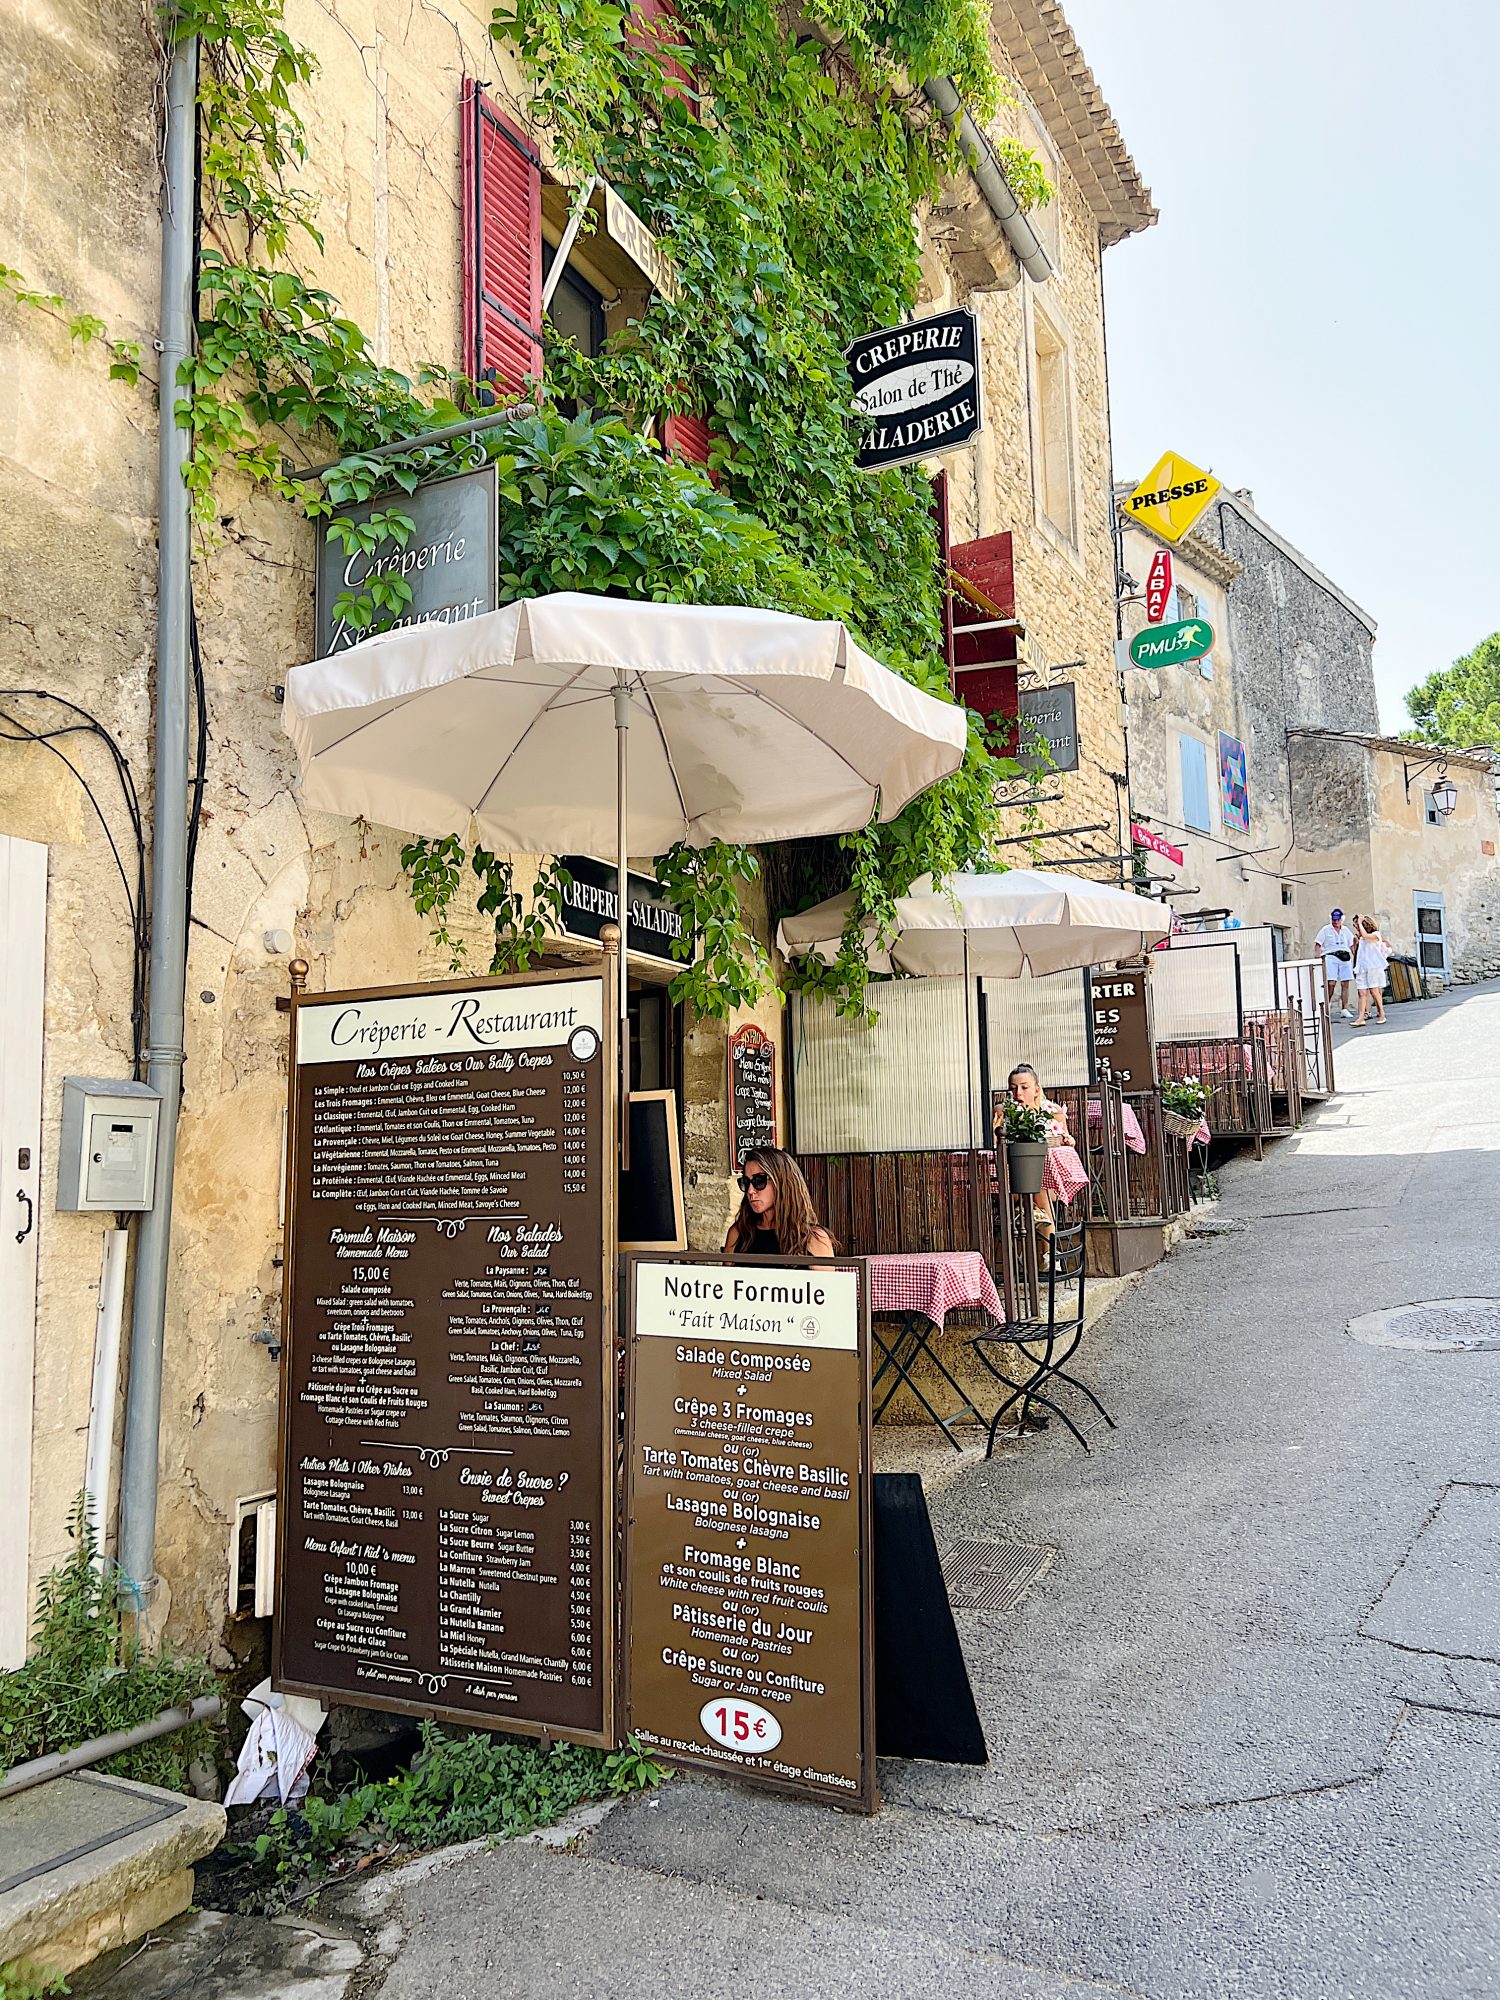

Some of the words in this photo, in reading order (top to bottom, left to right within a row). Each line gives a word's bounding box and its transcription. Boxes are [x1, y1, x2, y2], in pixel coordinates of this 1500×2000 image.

[856, 326, 963, 373] CREPERIE
[860, 388, 902, 412] Salon
[908, 378, 927, 398] de
[931, 364, 962, 391] Thé
[1131, 479, 1208, 511] PRESSE
[343, 531, 466, 588] Crêperie
[1149, 552, 1166, 617] TABAC
[326, 597, 485, 656] Resaurant
[1137, 637, 1177, 660] PMU
[1023, 708, 1062, 734] êperie
[563, 881, 618, 920] CREPERI
[1091, 983, 1135, 999] RTER
[331, 1009, 427, 1055] Crêperie
[446, 999, 578, 1045] Restaurant
[1095, 1009, 1120, 1024] ES
[1094, 1026, 1118, 1035] crées
[356, 1063, 377, 1078] Nos
[379, 1062, 412, 1079] Crêpes
[415, 1057, 448, 1074] Salées
[465, 1056, 485, 1071] Our
[488, 1052, 515, 1072] Salty
[518, 1052, 553, 1070] Crepes
[1095, 1056, 1110, 1067] es
[330, 1226, 373, 1244] Formule
[376, 1227, 416, 1243] Maison
[487, 1226, 512, 1242] Nos
[516, 1224, 563, 1242] Salades
[336, 1244, 383, 1258] Homemade
[385, 1245, 409, 1258] Menu
[500, 1245, 518, 1258] Our
[521, 1243, 551, 1257] Salad
[353, 1267, 380, 1282] 15,00
[382, 1268, 389, 1280] €
[664, 1276, 723, 1300] Notre
[734, 1279, 825, 1306] Formule
[676, 1346, 725, 1365] Salade
[730, 1350, 811, 1372] Composée
[712, 1367, 743, 1379] Mixed
[743, 1370, 773, 1382] Salad
[674, 1397, 717, 1418] Crêpe
[722, 1402, 731, 1418] 3
[737, 1403, 813, 1427] Fromages
[690, 1417, 698, 1428] 3
[699, 1419, 763, 1434] cheese-filled
[765, 1427, 794, 1439] crepe
[723, 1443, 739, 1454] ou
[742, 1446, 759, 1458] (or)
[300, 1456, 326, 1471] Autres
[328, 1458, 350, 1472] Plats
[357, 1460, 381, 1475] Other
[383, 1462, 412, 1477] Dishes
[460, 1467, 493, 1486] Envie
[496, 1468, 513, 1487] de
[517, 1471, 554, 1490] Sucre
[643, 1446, 677, 1465] Tarte
[680, 1450, 739, 1473] Tomates
[743, 1458, 794, 1479] Chèvre
[799, 1464, 848, 1486] Basilic
[643, 1464, 661, 1476] Tart
[663, 1468, 683, 1479] with
[686, 1470, 734, 1487] tomatoes,
[736, 1478, 761, 1489] goat
[762, 1480, 799, 1494] cheese
[801, 1486, 822, 1496] and
[823, 1487, 850, 1500] basil
[481, 1489, 513, 1504] Sweet
[512, 1491, 545, 1509] Crepes
[723, 1489, 739, 1500] ou
[742, 1492, 760, 1504] (or)
[667, 1493, 728, 1517] Lasagne
[733, 1502, 820, 1529] Bolognaise
[695, 1516, 747, 1533] Bolognese
[749, 1524, 789, 1539] lasagna
[304, 1537, 327, 1552] Menu
[329, 1540, 359, 1557] Enfant
[363, 1545, 381, 1559] Kid
[391, 1553, 416, 1564] menu
[685, 1545, 751, 1572] Fromage
[757, 1556, 800, 1579] Blanc
[663, 1563, 674, 1574] et
[676, 1566, 696, 1578] son
[698, 1570, 731, 1583] coulis
[733, 1573, 748, 1586] de
[750, 1576, 781, 1591] fruits
[784, 1583, 824, 1598] rouges
[439, 1589, 448, 1598] La
[449, 1590, 481, 1605] Chantilly
[660, 1576, 688, 1590] White
[690, 1581, 725, 1596] cheese
[728, 1588, 750, 1600] with
[751, 1593, 770, 1603] red
[772, 1594, 795, 1608] fruit
[797, 1601, 828, 1613] coulis
[440, 1602, 448, 1612] La
[449, 1603, 471, 1615] Grand
[473, 1606, 502, 1618] Marnier
[440, 1616, 448, 1625] La
[449, 1617, 476, 1629] Nutella
[477, 1620, 504, 1633] Banane
[673, 1604, 747, 1632] Pâtisserie
[752, 1618, 771, 1637] du
[777, 1623, 813, 1644] Jour
[691, 1626, 749, 1647] Homemade
[751, 1637, 792, 1655] Pastries
[662, 1647, 706, 1671] Crêpe
[710, 1660, 743, 1678] Sucre
[747, 1670, 762, 1682] ou
[766, 1671, 824, 1694] Confiture
[691, 1672, 722, 1687] Sugar
[723, 1681, 735, 1690] or
[736, 1682, 759, 1695] Jam
[761, 1688, 791, 1702] crepe
[715, 1707, 767, 1741] 15€
[634, 1728, 659, 1744] Salles
[660, 1737, 671, 1747] au
[672, 1740, 743, 1763] rez-de-chaussée
[745, 1756, 756, 1767] et
[773, 1760, 801, 1778] étage
[803, 1767, 857, 1790] climatisées
